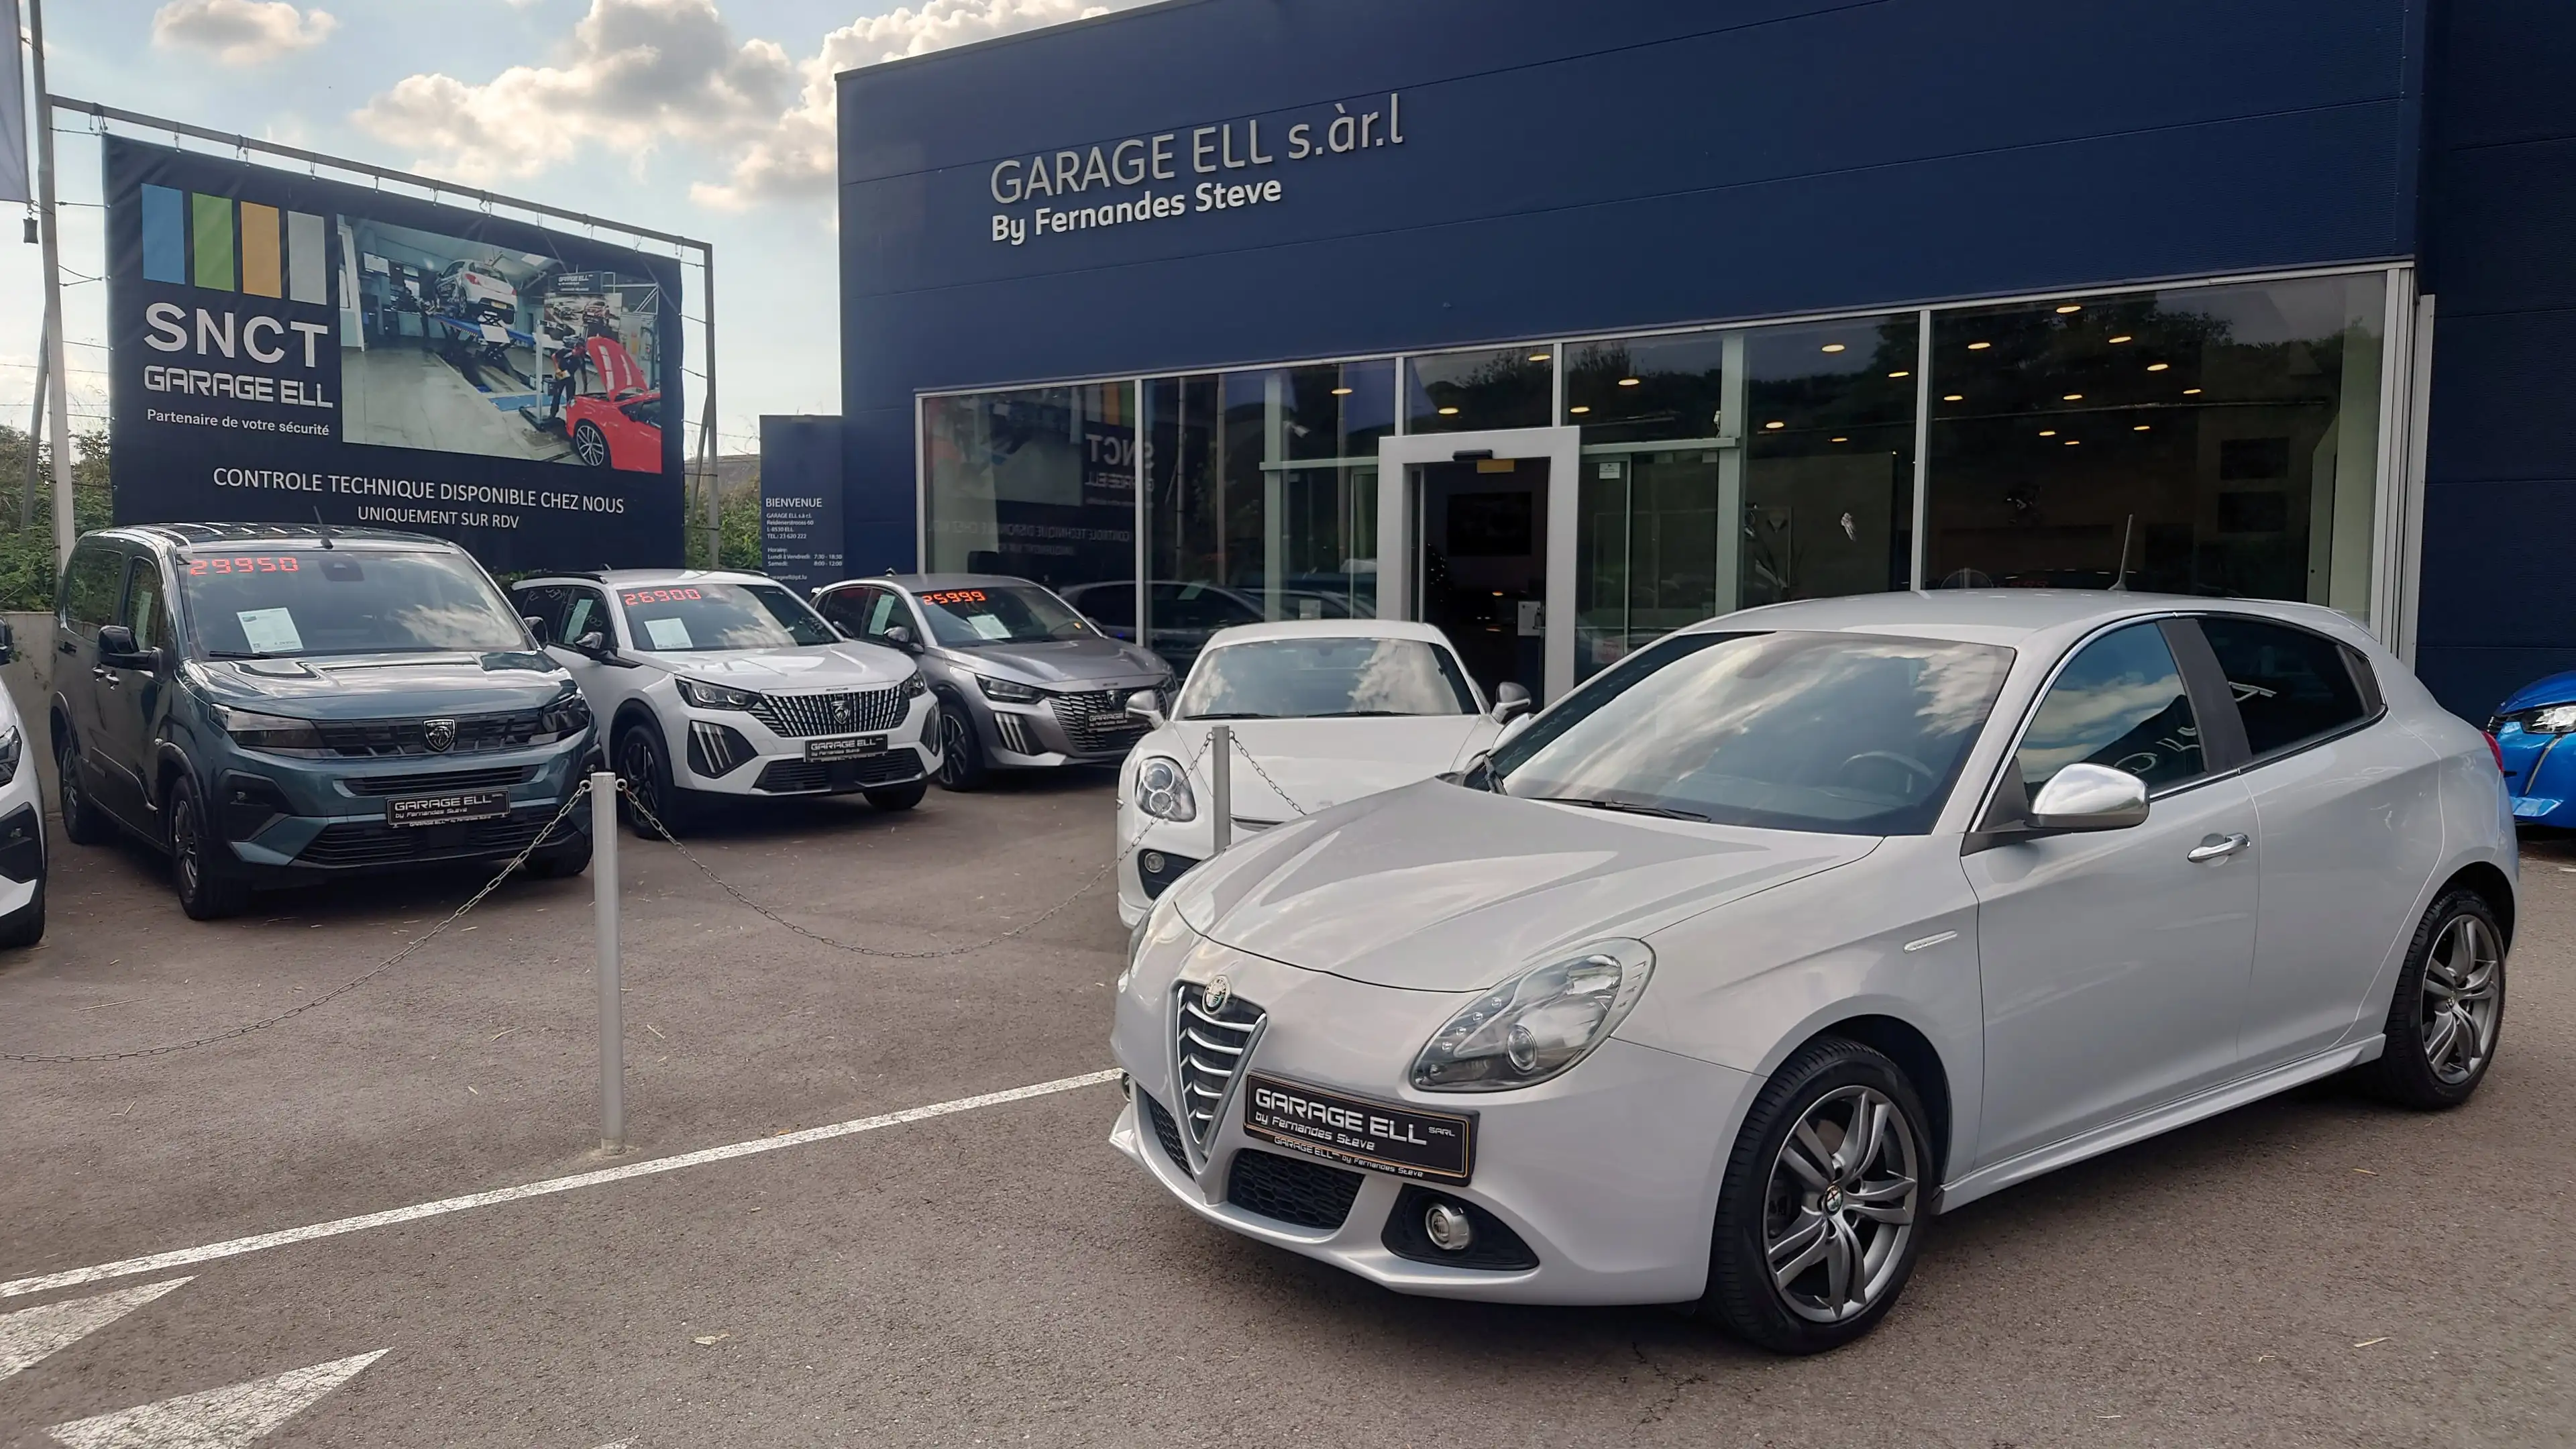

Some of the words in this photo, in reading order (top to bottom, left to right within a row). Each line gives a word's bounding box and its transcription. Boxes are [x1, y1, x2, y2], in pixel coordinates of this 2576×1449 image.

[990, 133, 1175, 203] GARAGE
[1193, 119, 1273, 173] ELL
[1287, 93, 1403, 160] s.àr.l
[991, 214, 1025, 245] By
[1034, 191, 1185, 235] Fernandes
[1195, 179, 1282, 212] Steve
[144, 303, 328, 368] SNCT
[144, 366, 274, 402] GARAGE
[280, 379, 333, 408] ELL
[147, 409, 218, 427] Partenaire
[222, 416, 238, 428] de
[242, 418, 275, 431] votre
[278, 421, 329, 436] sécurité
[213, 468, 323, 492] CONTROLE
[327, 474, 435, 499] TECHNIQUE
[440, 483, 537, 506] DISPONIBLE
[541, 492, 579, 511] CHEZ
[582, 496, 625, 514] NOUS
[765, 498, 822, 507] BIENVENUE
[358, 506, 458, 525] UNIQUEMENT
[461, 512, 488, 527] SUR
[492, 515, 519, 529] RDV
[190, 557, 299, 576] 29950
[623, 589, 702, 606] 26900
[922, 591, 986, 606] 25999
[1089, 713, 1124, 722] GARAGE
[810, 740, 855, 751] GARAGE
[857, 738, 876, 747] ELL
[394, 798, 461, 811] GARAGE
[464, 796, 492, 805] ELL
[407, 809, 444, 817] Fernandes
[1255, 1088, 1363, 1132] GARAGE
[1370, 1116, 1427, 1145] ELL
[1428, 1126, 1456, 1138] SARL
[1255, 1110, 1269, 1125] by
[1272, 1116, 1332, 1140] Fernandes
[1336, 1134, 1375, 1151] Steve
[1274, 1136, 1313, 1155] GARAGE
[1315, 1148, 1333, 1159] ELL
[1342, 1155, 1351, 1163] by
[1354, 1158, 1395, 1173] Fernandes
[1398, 1167, 1423, 1177] Steve
